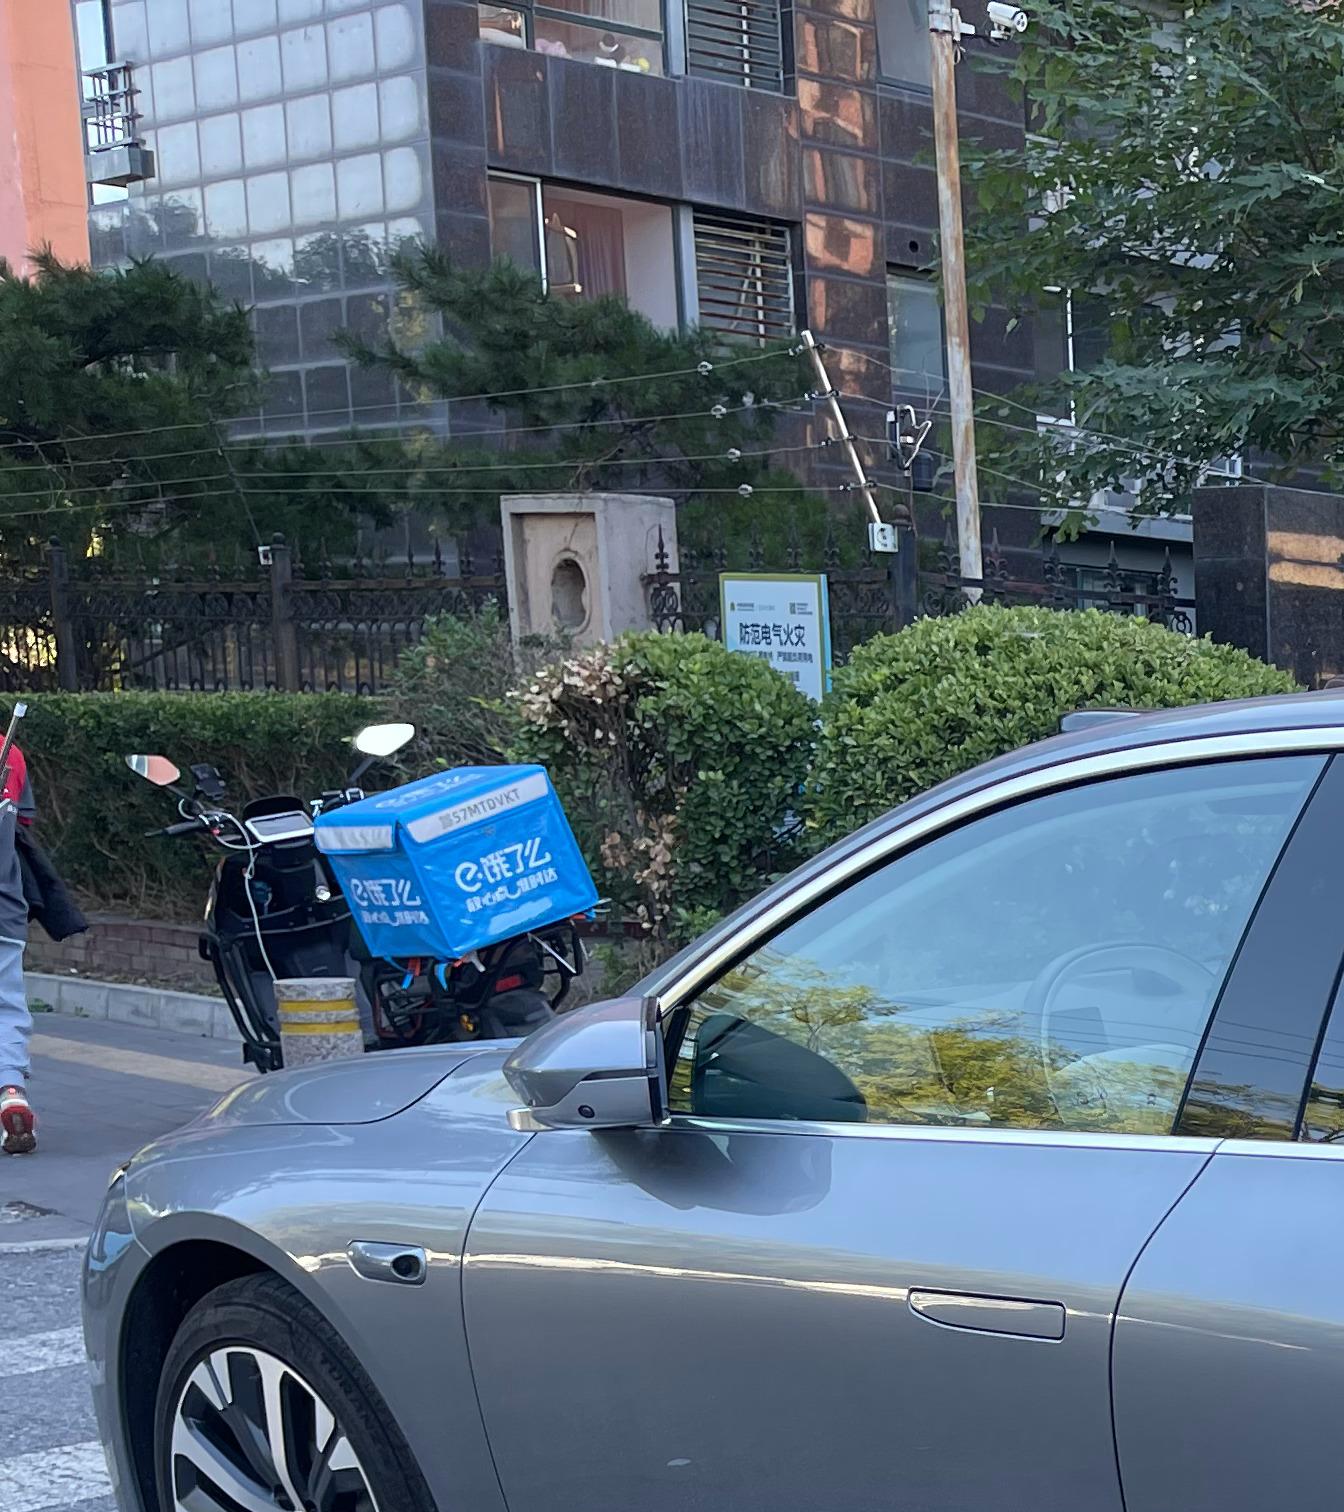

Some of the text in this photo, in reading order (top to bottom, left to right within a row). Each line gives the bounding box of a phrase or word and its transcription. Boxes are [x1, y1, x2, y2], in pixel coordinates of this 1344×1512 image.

[739, 622, 806, 647] 防范电气火灾
